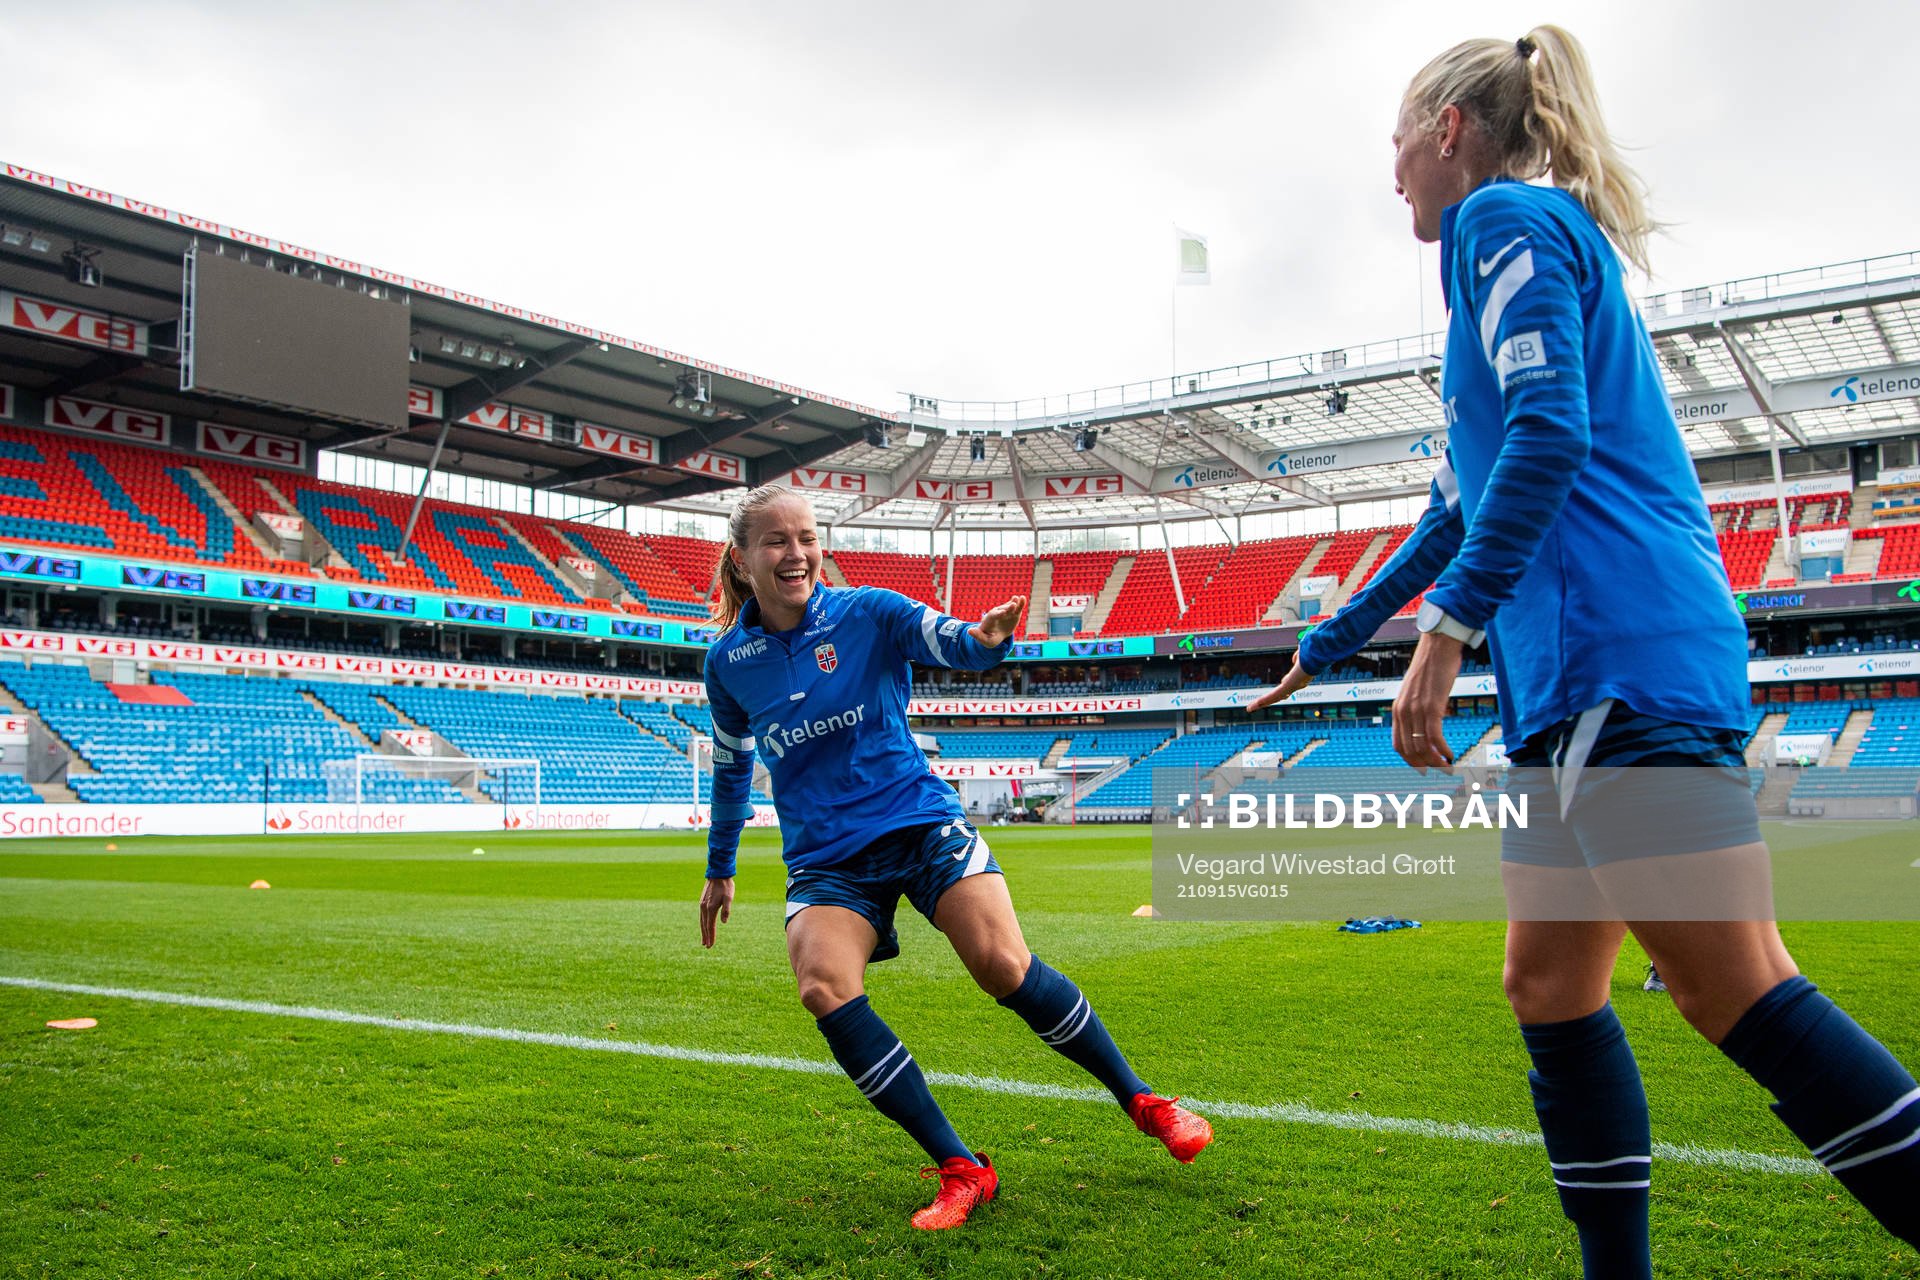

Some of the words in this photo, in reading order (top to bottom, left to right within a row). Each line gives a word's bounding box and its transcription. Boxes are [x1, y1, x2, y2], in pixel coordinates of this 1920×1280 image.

[16, 298, 135, 350] VG
[1502, 336, 1537, 363] NB
[1861, 376, 1920, 395] teleno
[54, 398, 163, 441] VG
[467, 403, 545, 438] VG
[1674, 402, 1728, 419] elenor
[205, 426, 299, 464] VG
[583, 424, 652, 461] VG
[679, 451, 739, 479] VG
[1289, 453, 1337, 470] telenor
[792, 469, 866, 492] VG
[916, 480, 992, 500] VG
[1045, 475, 1123, 496] VG
[0, 553, 80, 579] VG
[123, 566, 205, 592] VG
[242, 579, 315, 603] VG
[349, 591, 415, 614] VG
[444, 601, 506, 623] VG
[532, 611, 587, 631] VG
[612, 620, 662, 639] VG
[727, 642, 756, 663] KIWI
[1068, 641, 1123, 656] VG
[1, 632, 63, 650] VG
[77, 639, 135, 656] VG
[149, 643, 202, 660] VG
[215, 649, 266, 665] VG
[277, 654, 325, 669] VG
[336, 658, 381, 673] VG
[392, 662, 434, 680] VG
[444, 666, 485, 680] VG
[494, 670, 532, 684] VG
[541, 673, 577, 687] VG
[585, 676, 620, 690] VG
[628, 680, 661, 693] VG
[668, 683, 700, 696] VG
[1790, 664, 1824, 674] telenor
[1874, 660, 1911, 669] telenor
[1358, 686, 1385, 696] telenor
[917, 702, 958, 713] VG
[964, 702, 1005, 713] VG
[1010, 702, 1051, 713] VG
[1056, 701, 1097, 712] VG
[1102, 699, 1140, 710] VG
[781, 704, 865, 747] telenor
[930, 765, 973, 775] VG
[990, 765, 1033, 775] VG
[2, 811, 142, 835] Santander
[298, 810, 407, 831] Santander
[526, 810, 611, 829] Santander
